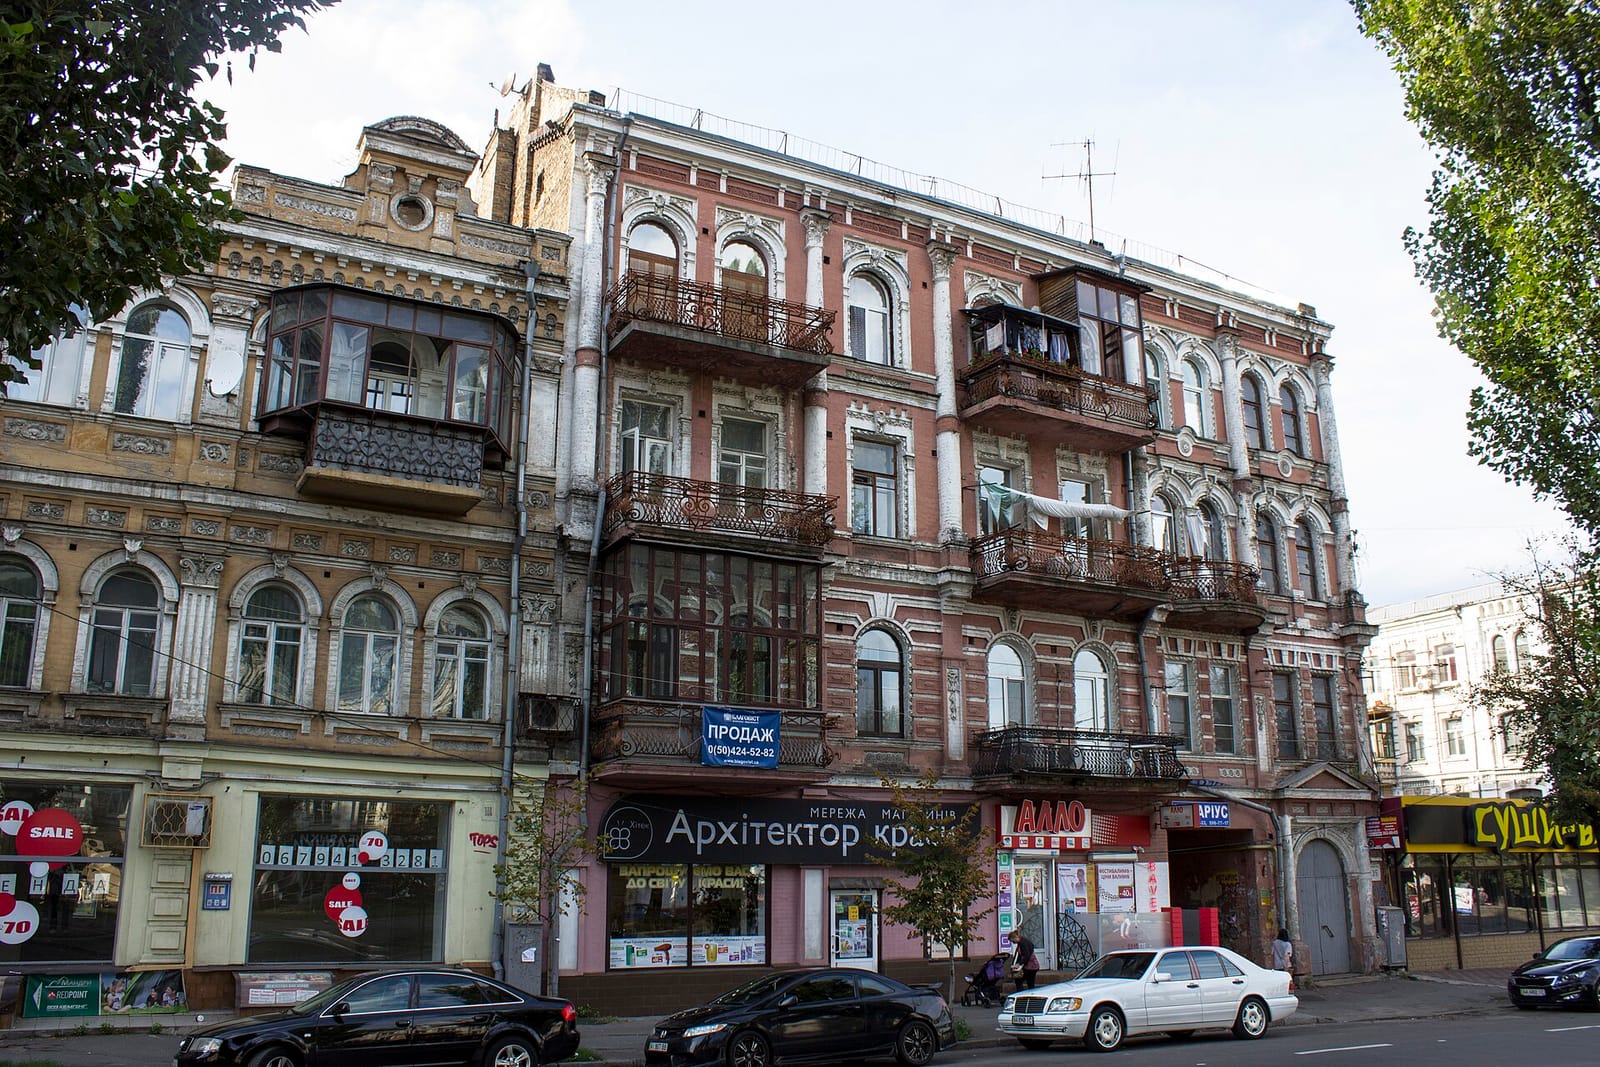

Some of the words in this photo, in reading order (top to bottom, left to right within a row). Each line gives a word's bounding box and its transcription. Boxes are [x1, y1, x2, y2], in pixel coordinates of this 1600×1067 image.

[708, 724, 775, 744] ПРОДАЖ
[708, 745, 775, 758] 0(50)424-52-82
[810, 807, 866, 819] МЕРЕЖА
[882, 809, 956, 820] МАГИНІВ
[1018, 799, 1086, 833] АЛЛО
[30, 826, 74, 839] SALE
[665, 808, 860, 857] Архітектор
